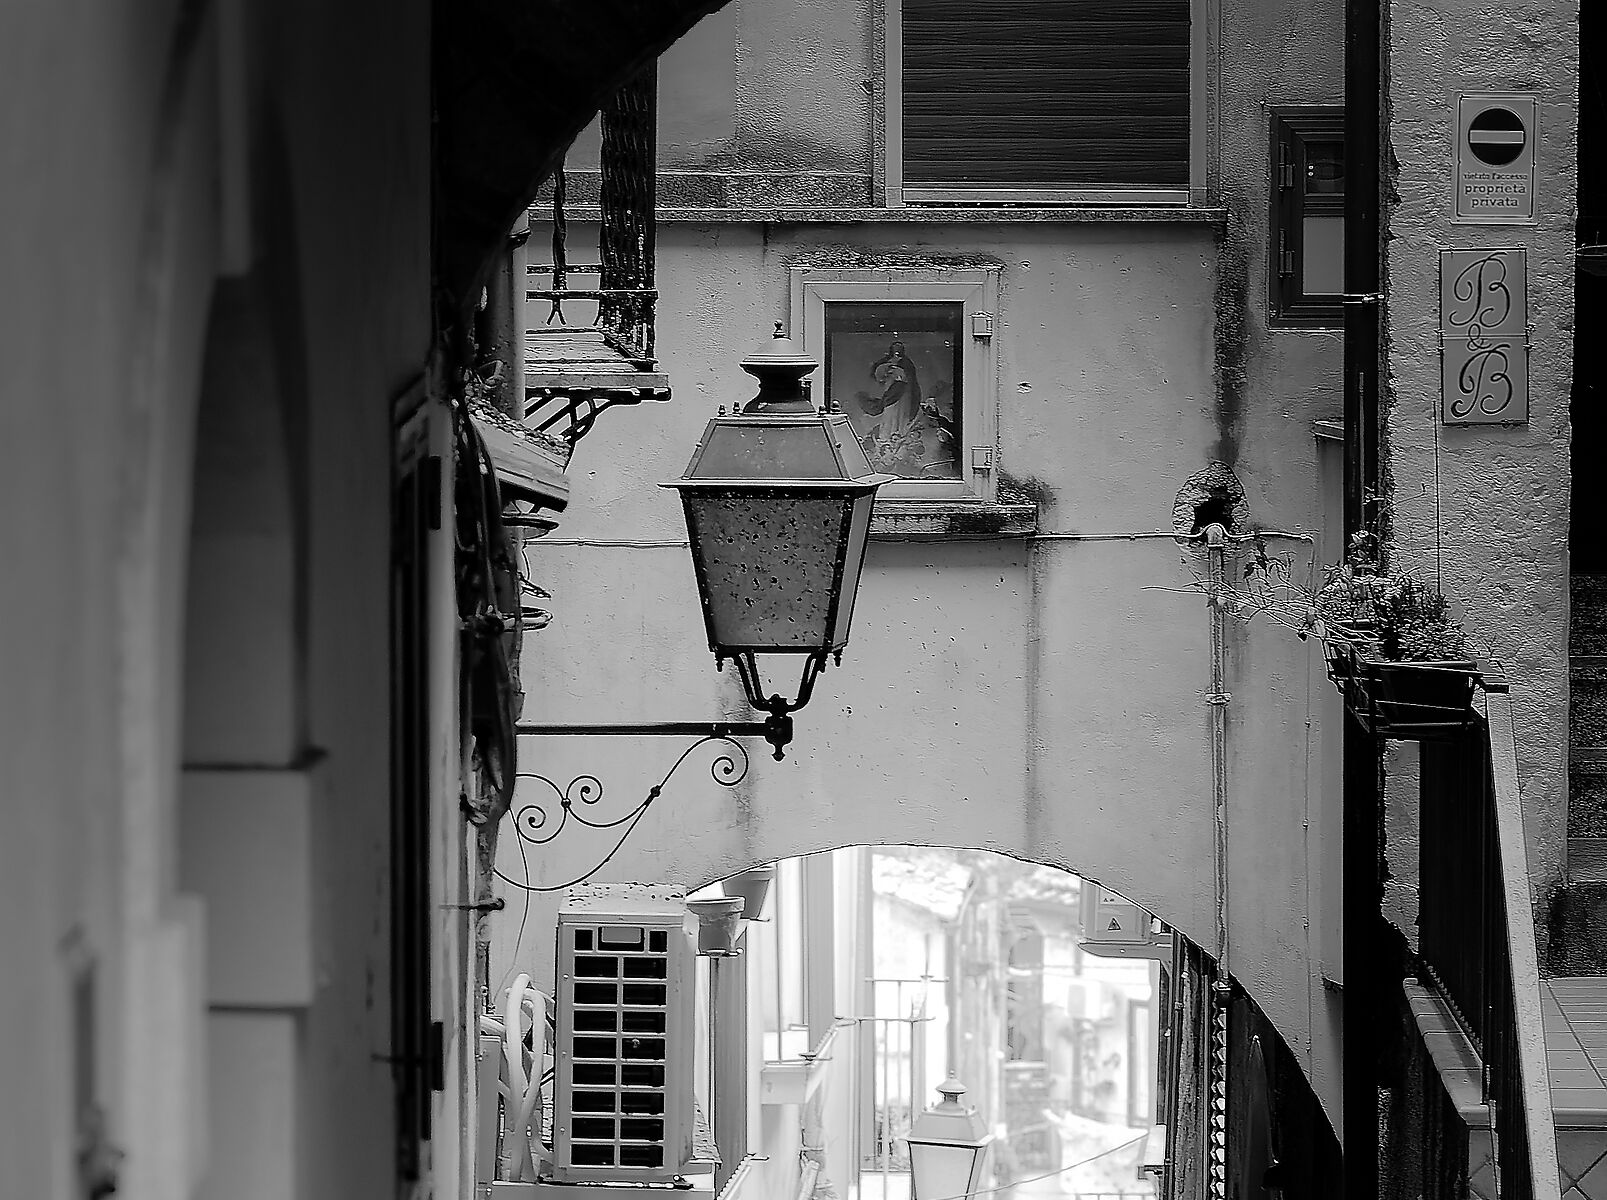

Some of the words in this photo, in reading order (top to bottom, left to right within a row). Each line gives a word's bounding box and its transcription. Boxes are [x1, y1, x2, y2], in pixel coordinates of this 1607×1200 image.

[1464, 183, 1527, 195] proprietà
[1471, 196, 1519, 208] privata
[1449, 252, 1511, 328] B
[1466, 323, 1493, 351] &
[1450, 343, 1513, 418] B
